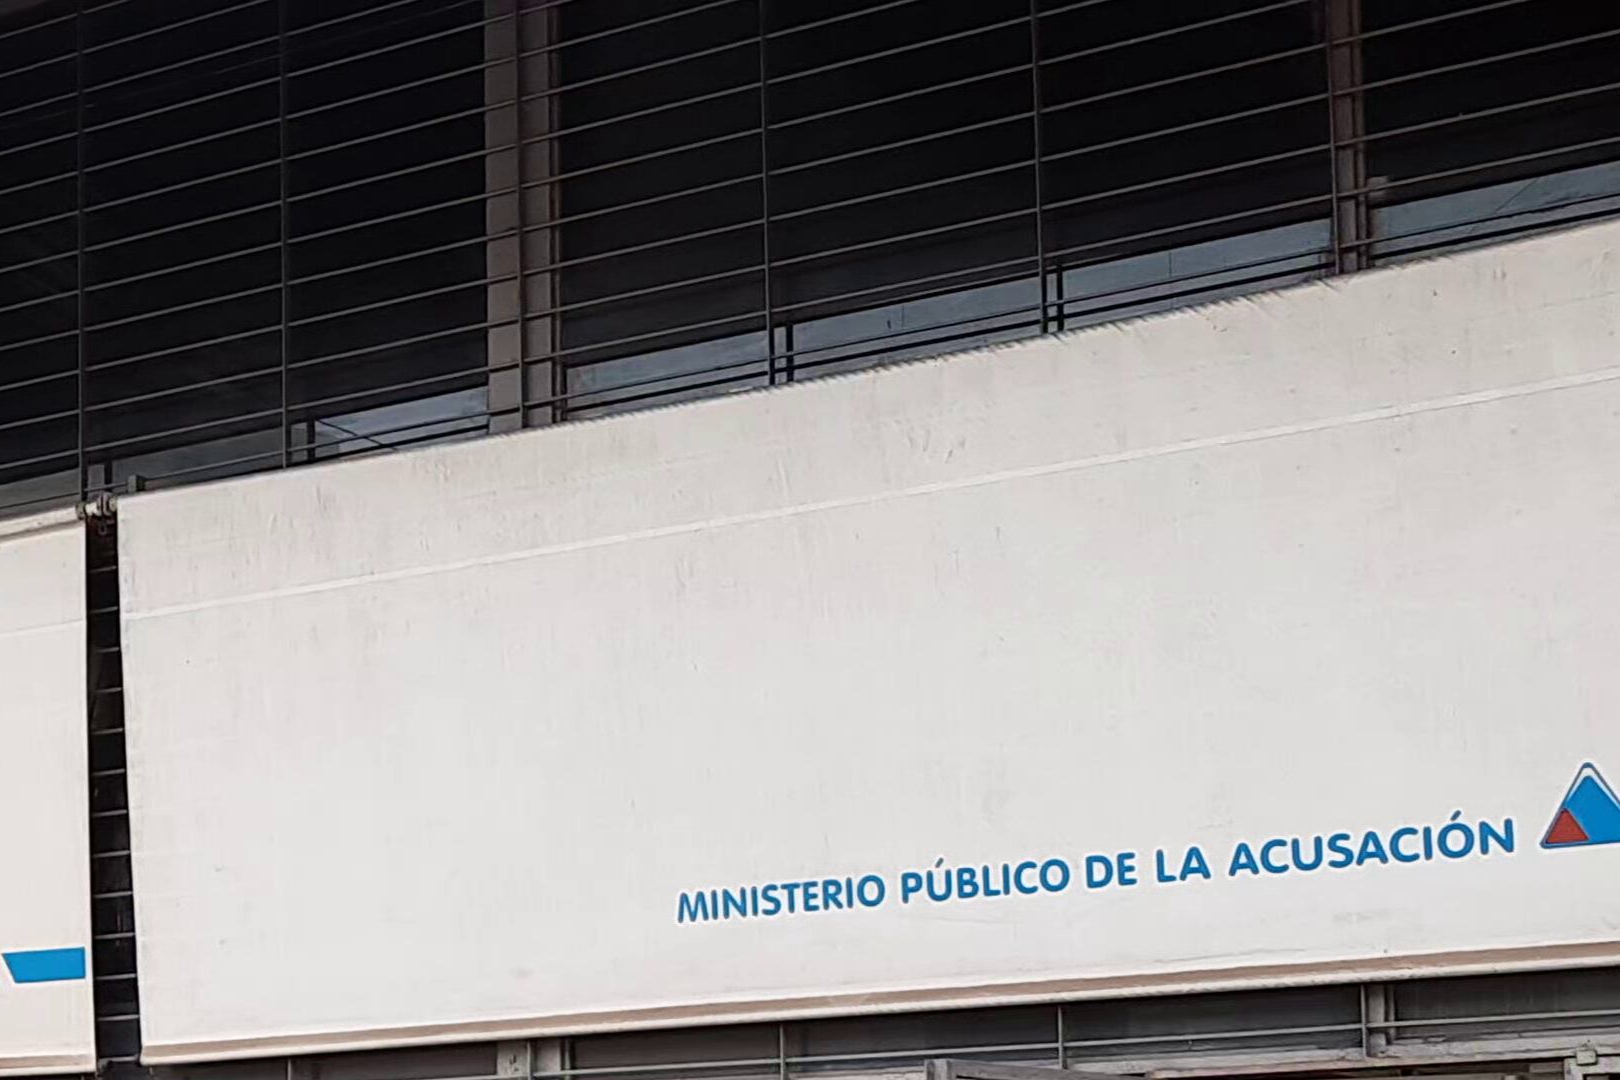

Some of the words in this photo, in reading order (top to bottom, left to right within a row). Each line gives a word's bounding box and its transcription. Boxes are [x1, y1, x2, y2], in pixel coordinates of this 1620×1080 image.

[677, 874, 886, 925] MINISTERIO
[900, 857, 1071, 904] PÚBLICO
[1085, 852, 1138, 889] DE
[1156, 846, 1211, 883] LA
[1228, 810, 1516, 877] ACUSACIÓN
